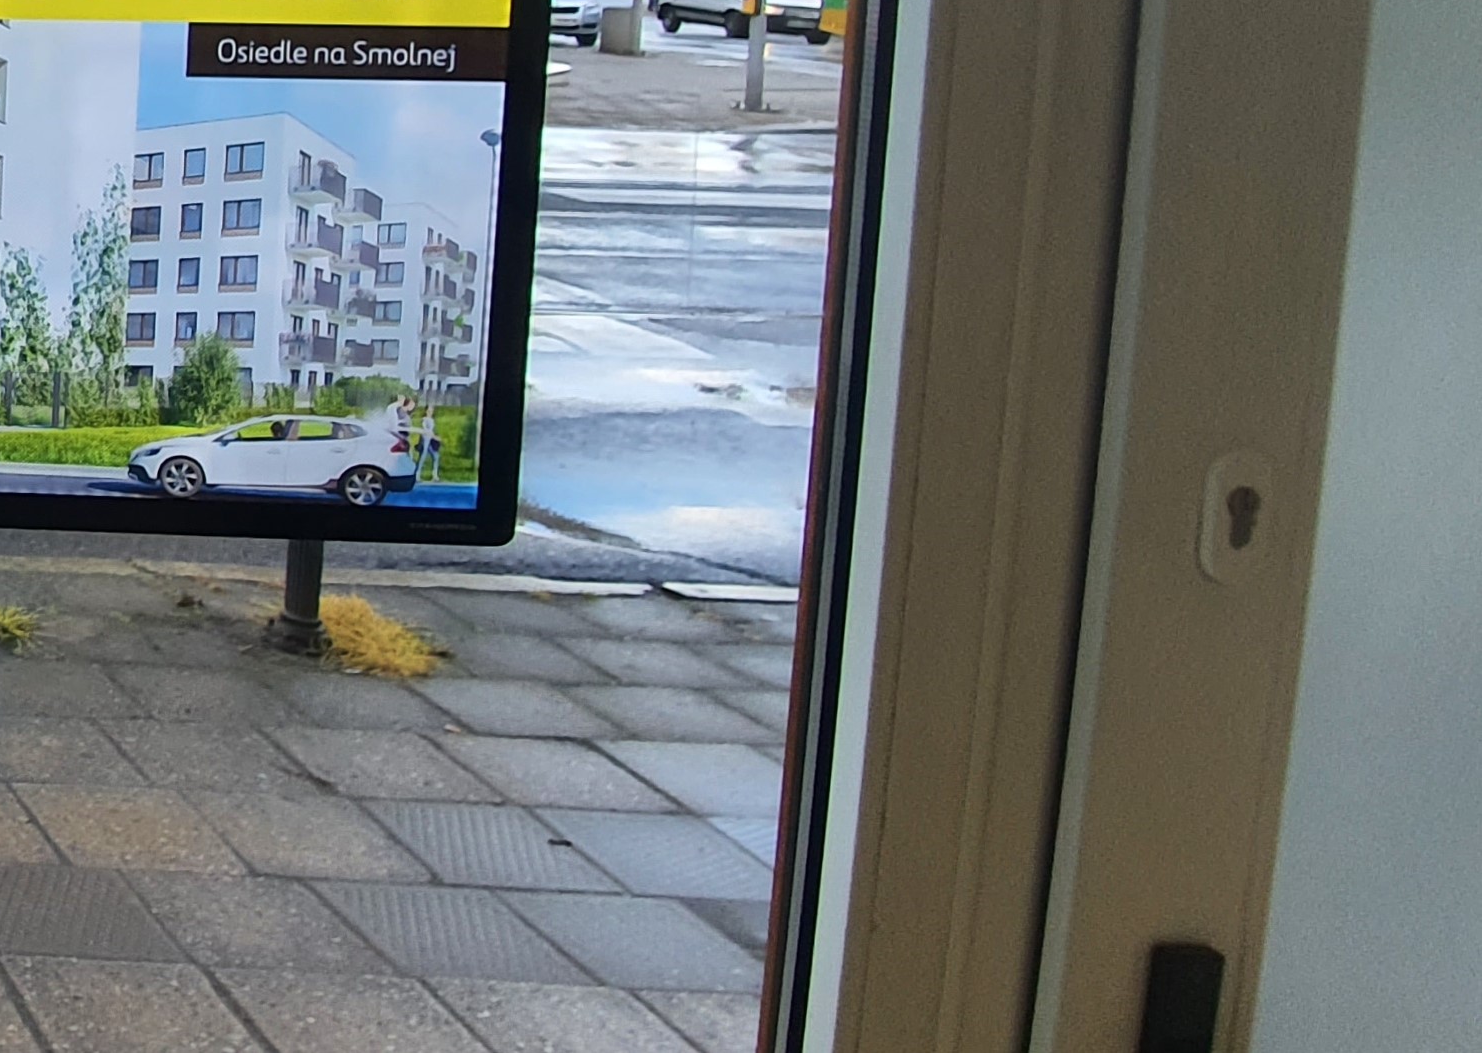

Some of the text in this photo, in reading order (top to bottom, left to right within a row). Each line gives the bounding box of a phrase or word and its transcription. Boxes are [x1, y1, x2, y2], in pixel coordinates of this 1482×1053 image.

[217, 38, 458, 73] Osiedle na Smolnej
